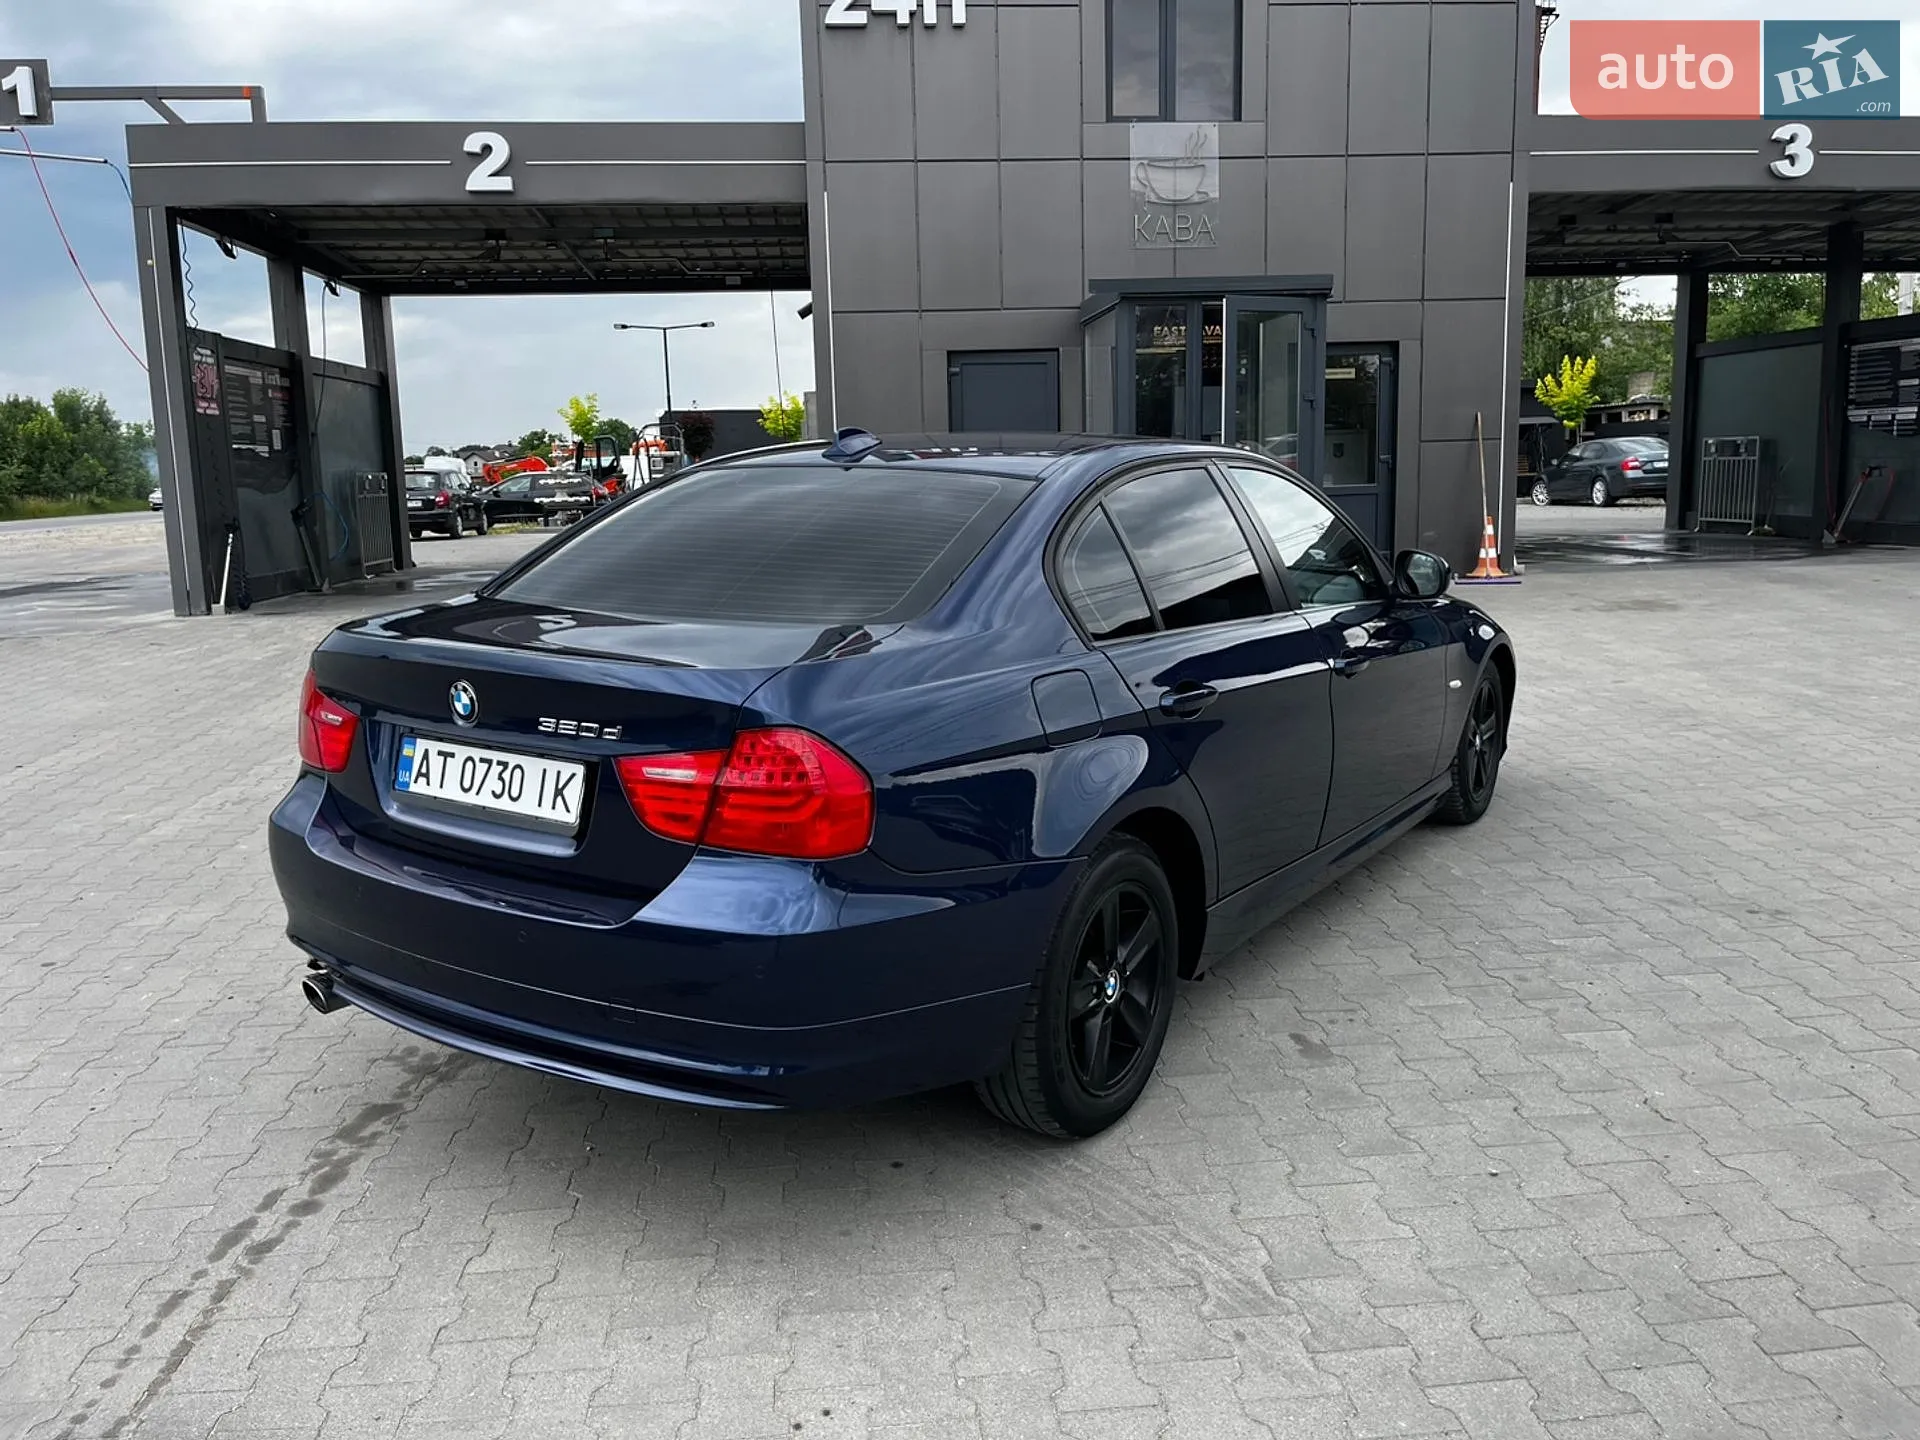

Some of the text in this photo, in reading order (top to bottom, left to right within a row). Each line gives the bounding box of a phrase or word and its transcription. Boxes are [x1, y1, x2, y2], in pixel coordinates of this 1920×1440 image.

[2, 66, 38, 117] 1
[463, 130, 514, 192] 2
[1768, 122, 1815, 179] 3
[538, 717, 622, 740] 320d
[398, 748, 577, 814] UA AT 0730 IK
